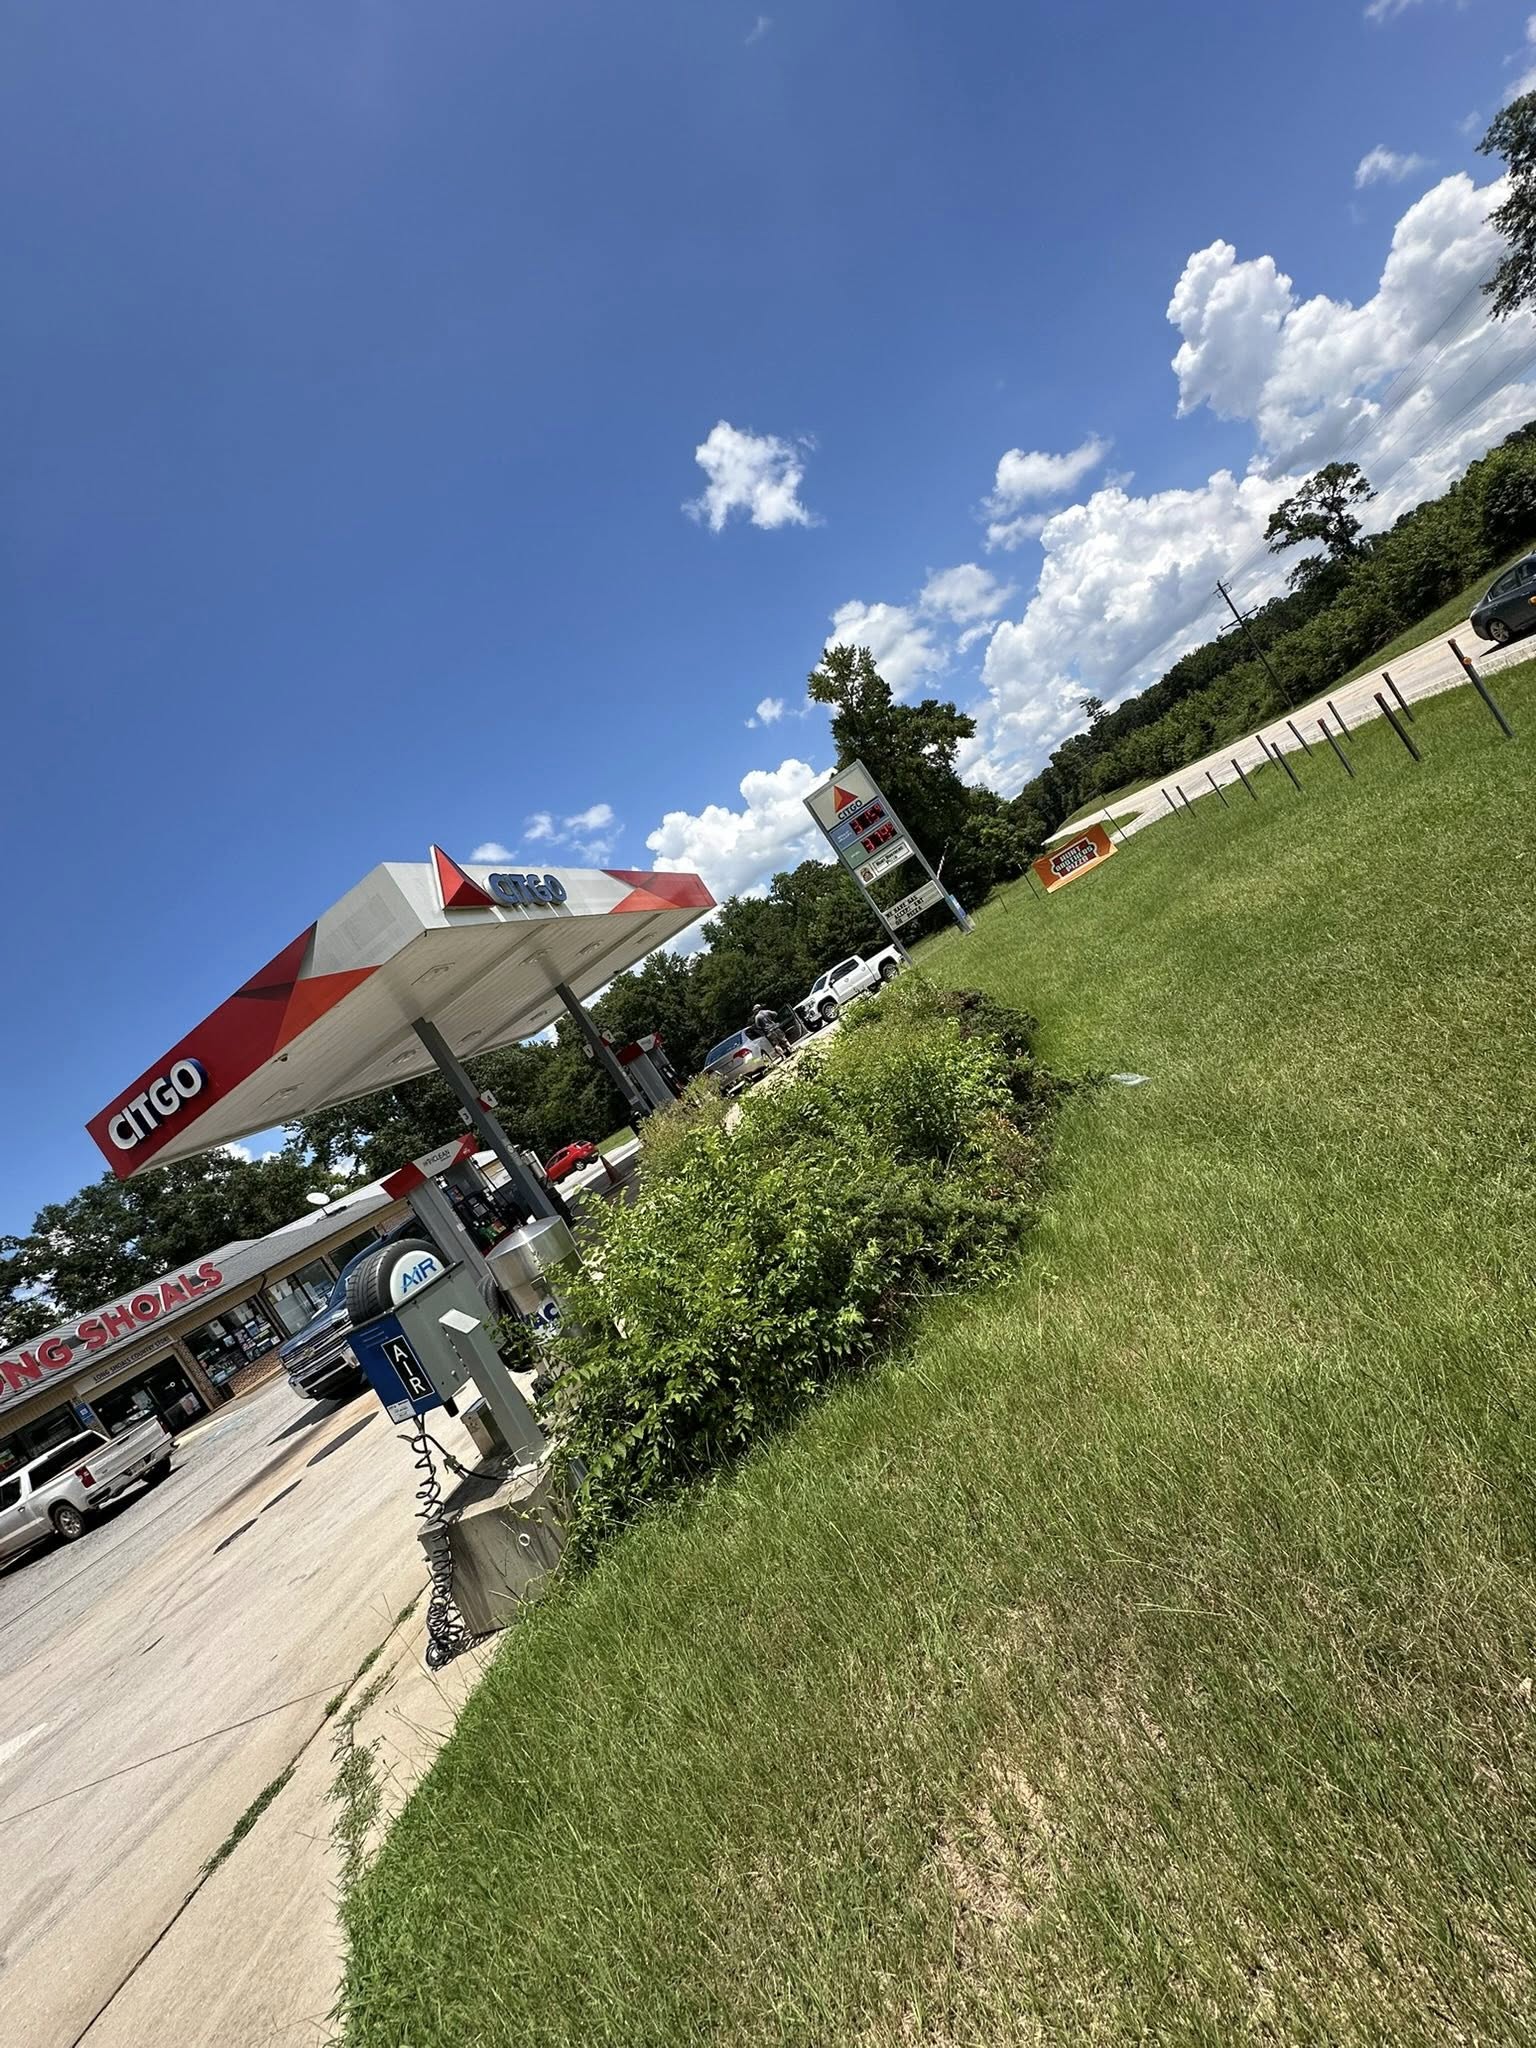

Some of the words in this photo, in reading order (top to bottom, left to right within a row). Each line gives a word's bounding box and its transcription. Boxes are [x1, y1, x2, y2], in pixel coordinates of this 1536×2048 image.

[838, 799, 863, 820] CITGO
[1055, 845, 1093, 872] BROTHERS
[1060, 846, 1080, 861] HUNT
[1065, 856, 1089, 872] PIZZA
[484, 873, 568, 907] CITGO
[108, 1058, 205, 1149] CITGO
[0, 1337, 73, 1395] NG
[76, 1262, 224, 1350] SHOALS
[93, 1369, 110, 1382] LONG
[110, 1357, 131, 1373] SHOALS
[131, 1344, 155, 1361] COUNTRY
[154, 1336, 170, 1348] STORE
[393, 1344, 426, 1394] AIR
